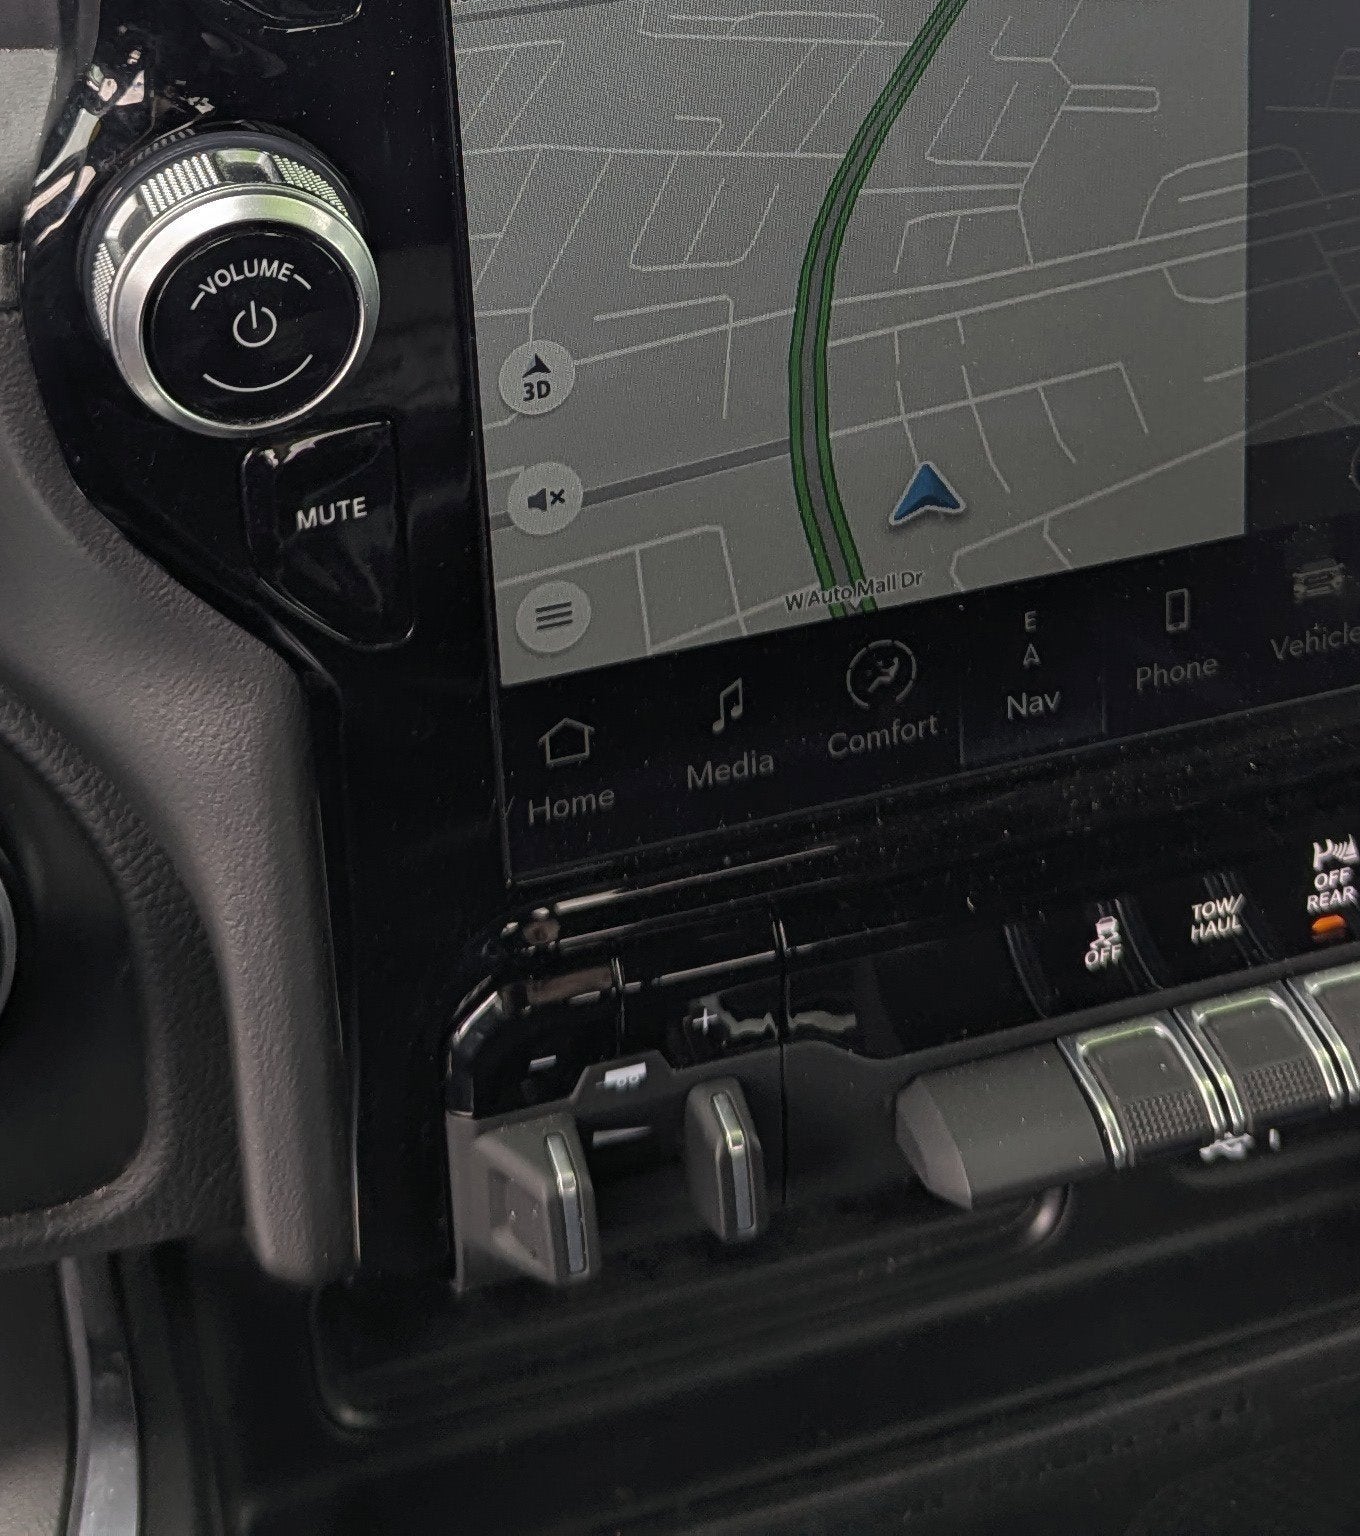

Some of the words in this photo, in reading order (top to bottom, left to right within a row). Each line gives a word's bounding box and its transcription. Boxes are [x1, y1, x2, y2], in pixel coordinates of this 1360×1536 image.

[199, 257, 296, 296] VOLUME
[522, 379, 551, 403] 3D
[296, 496, 369, 531] MUTE
[785, 594, 806, 611] W
[808, 584, 852, 607] Auto
[856, 574, 897, 598] Mall
[901, 569, 925, 590] Dr
[1135, 655, 1219, 692] Phone
[1006, 689, 1062, 721] Nav
[826, 712, 939, 758] Comfort
[686, 751, 775, 790] Media
[527, 785, 616, 825] Home
[1313, 866, 1353, 891] OFF
[1190, 893, 1245, 922] TOW/
[1307, 884, 1357, 913] REAR
[1190, 913, 1242, 943] HAUL
[1084, 942, 1123, 971] OFF
